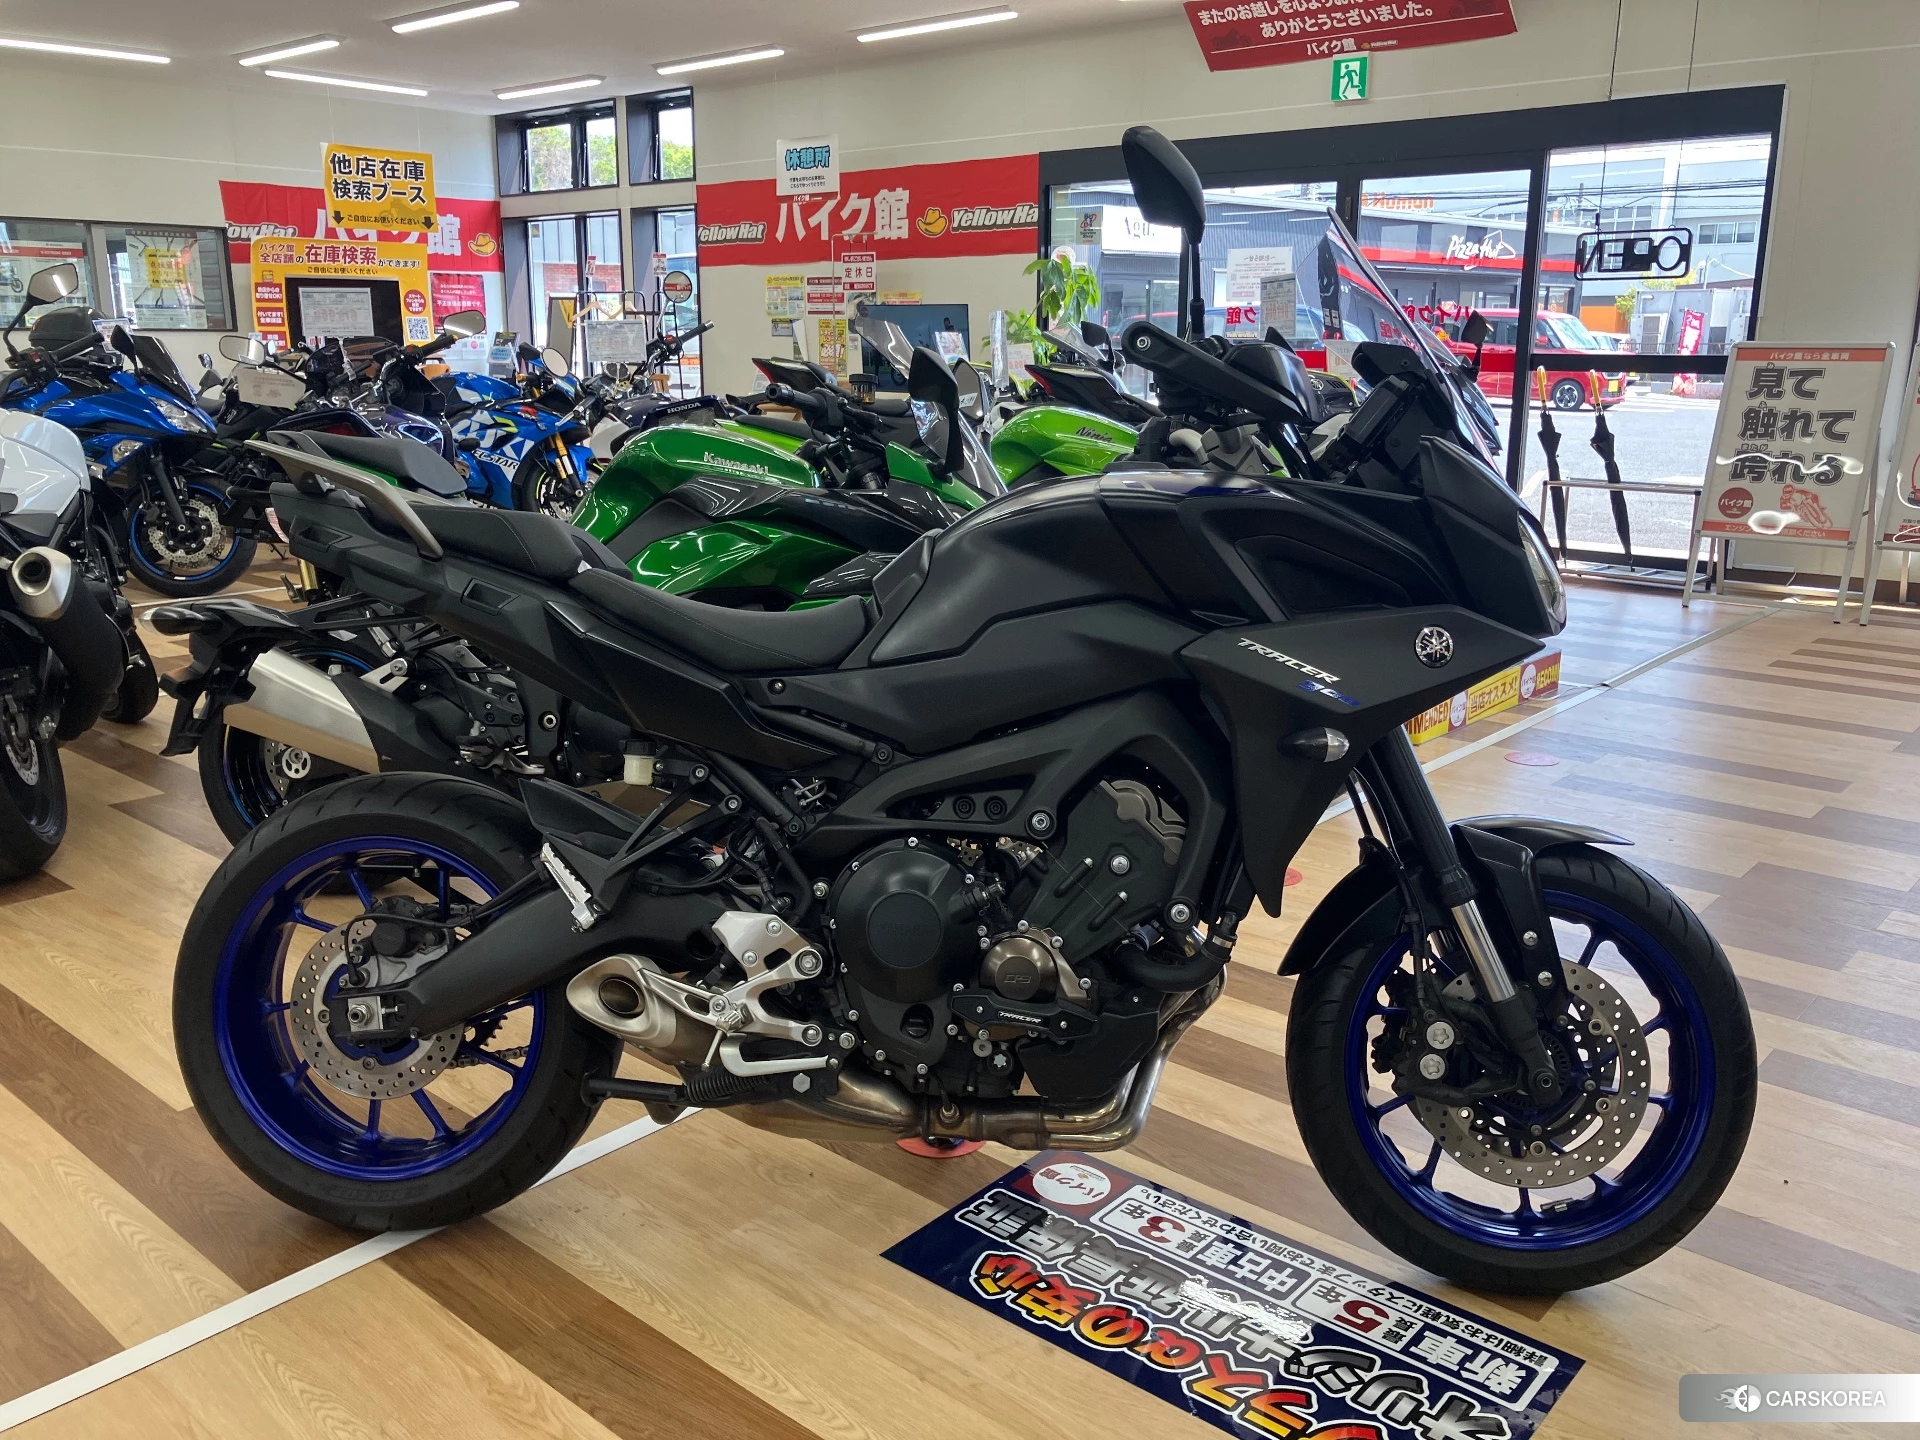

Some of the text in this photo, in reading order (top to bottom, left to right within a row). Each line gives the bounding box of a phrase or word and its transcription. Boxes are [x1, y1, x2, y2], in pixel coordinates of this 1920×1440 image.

[1260, 6, 1433, 39] ありがとうございました。
[1307, 38, 1357, 55] バイク館
[329, 152, 426, 182] 他店在庫
[785, 145, 831, 171] 休憩所
[333, 177, 427, 205] 検索ブース
[347, 214, 420, 226] ご自由にお使いください
[775, 188, 910, 243] バイク館
[953, 205, 1038, 228] YellowHa
[260, 243, 295, 253] バイク館
[1446, 235, 1504, 260] Pizza Hut
[307, 266, 378, 276] ご自由にお使いください
[845, 266, 872, 278] 定休日
[1770, 352, 1850, 361] バイク館なら全車両
[1746, 366, 1826, 400] 見て
[667, 402, 702, 414] HONDA
[1076, 426, 1114, 443] Ninja
[1737, 405, 1857, 443] 触れて
[703, 451, 769, 475] Kawasaki
[1237, 637, 1341, 685] TRACER
[1470, 675, 1518, 714] 当店オススメ!
[999, 1011, 1042, 1024] TRACER
[1039, 1167, 1105, 1200] バイク館
[1141, 1188, 1553, 1370] 詳細はお気軽にスタッフまでお問い合わせください。
[1196, 1240, 1299, 1293] 中古車
[1424, 1330, 1527, 1396] 新車
